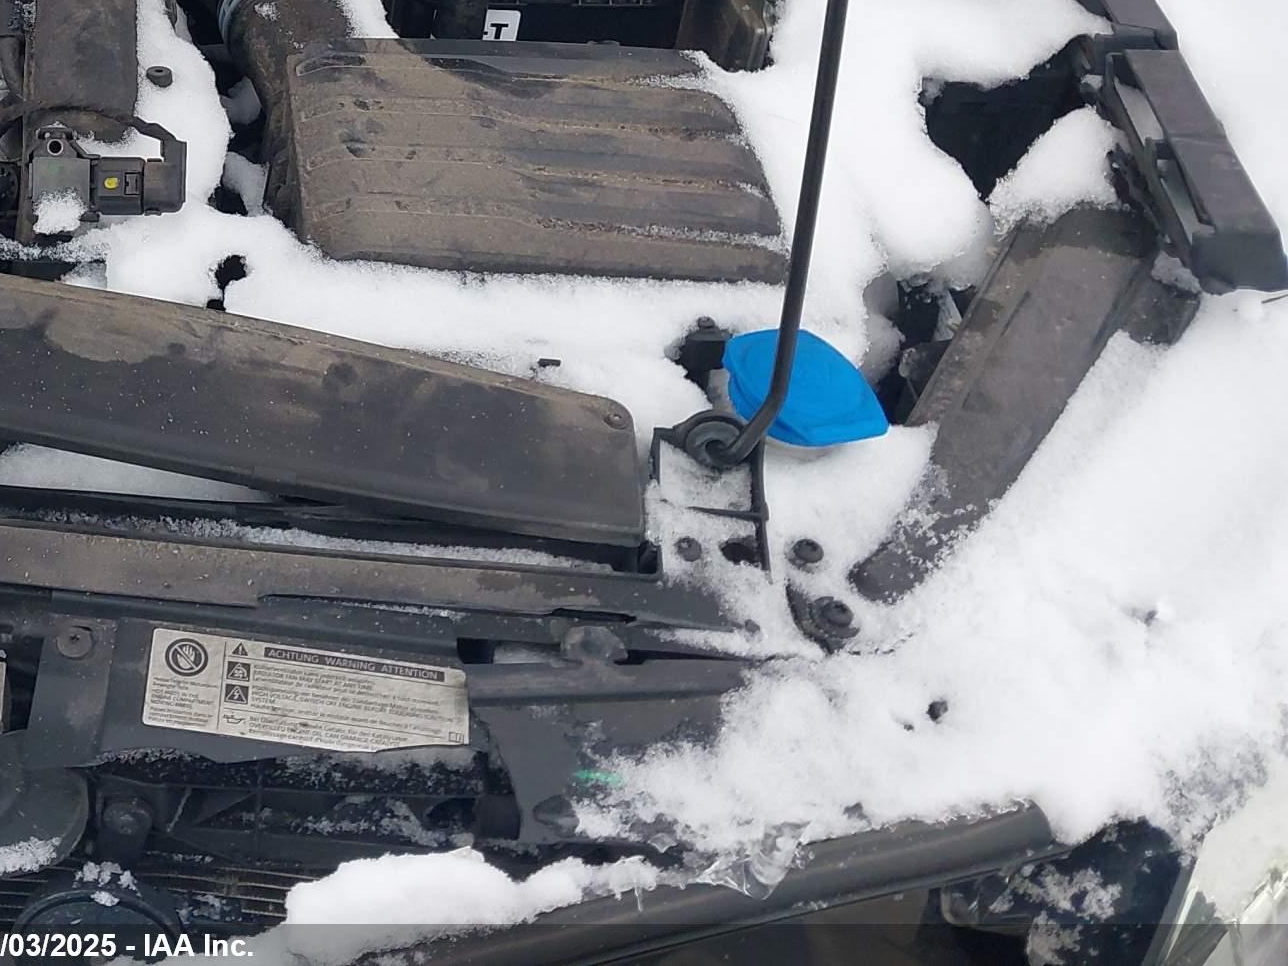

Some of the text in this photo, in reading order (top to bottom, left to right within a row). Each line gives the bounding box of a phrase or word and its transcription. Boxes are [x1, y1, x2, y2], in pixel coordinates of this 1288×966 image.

[268, 648, 319, 664] ACHTUNG
[324, 656, 376, 672] WARNING
[380, 664, 438, 680] ATTENTION
